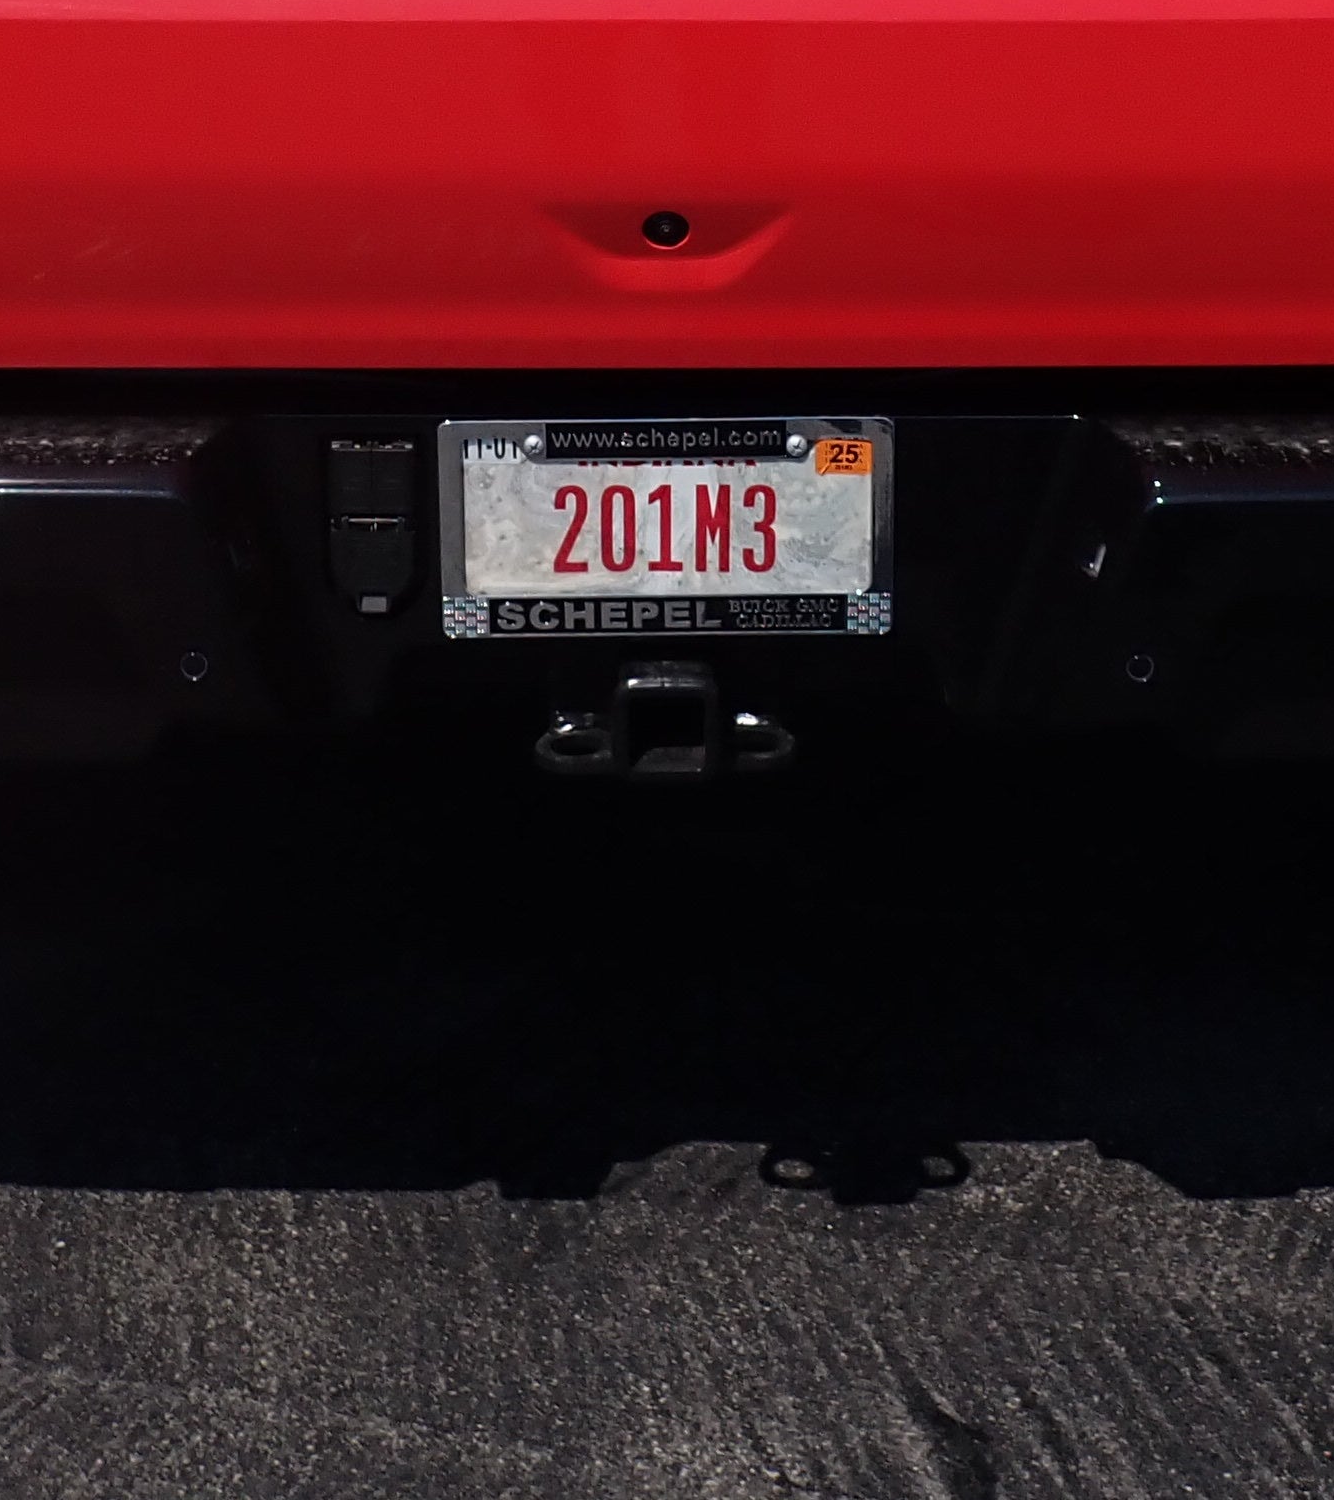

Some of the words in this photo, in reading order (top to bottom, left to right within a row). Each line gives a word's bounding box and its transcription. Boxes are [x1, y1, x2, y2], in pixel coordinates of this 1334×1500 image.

[551, 427, 782, 452] www.schepel.com
[829, 443, 859, 463] 25
[553, 484, 777, 573] 201M3
[497, 601, 722, 629] SCHEPEL
[795, 598, 839, 613] GMC
